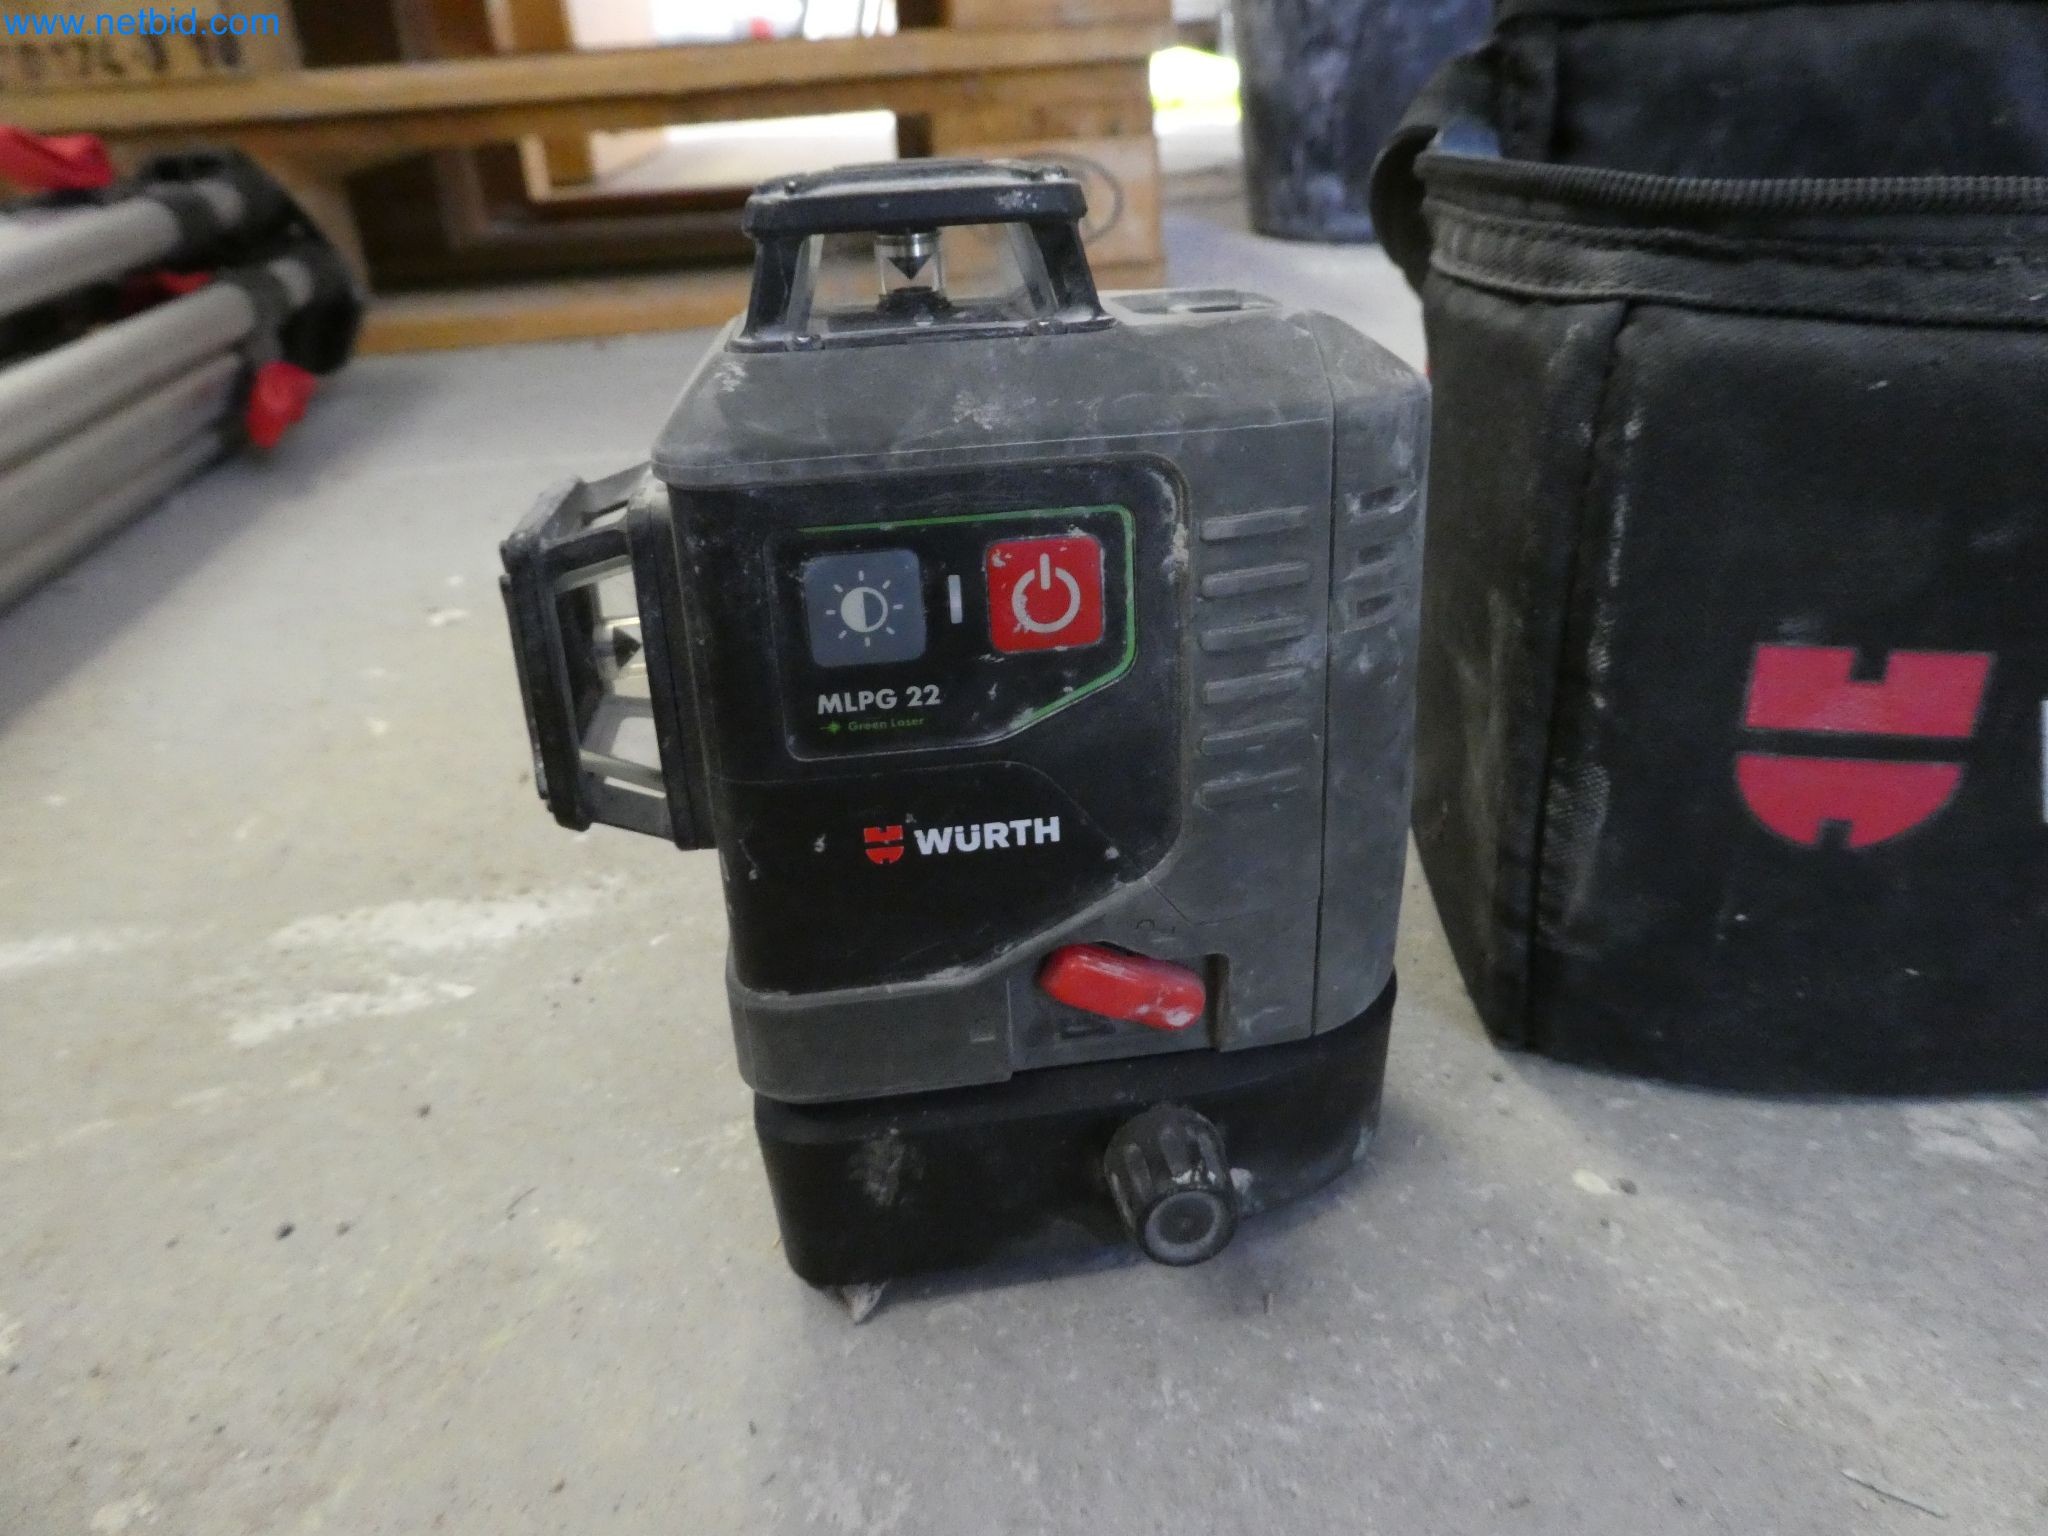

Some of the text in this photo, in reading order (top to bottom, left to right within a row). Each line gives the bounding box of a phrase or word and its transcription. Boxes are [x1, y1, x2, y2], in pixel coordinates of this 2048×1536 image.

[817, 684, 942, 715] MLPG 22
[847, 717, 925, 732] Green Laser
[914, 816, 1061, 855] WÜRTH
